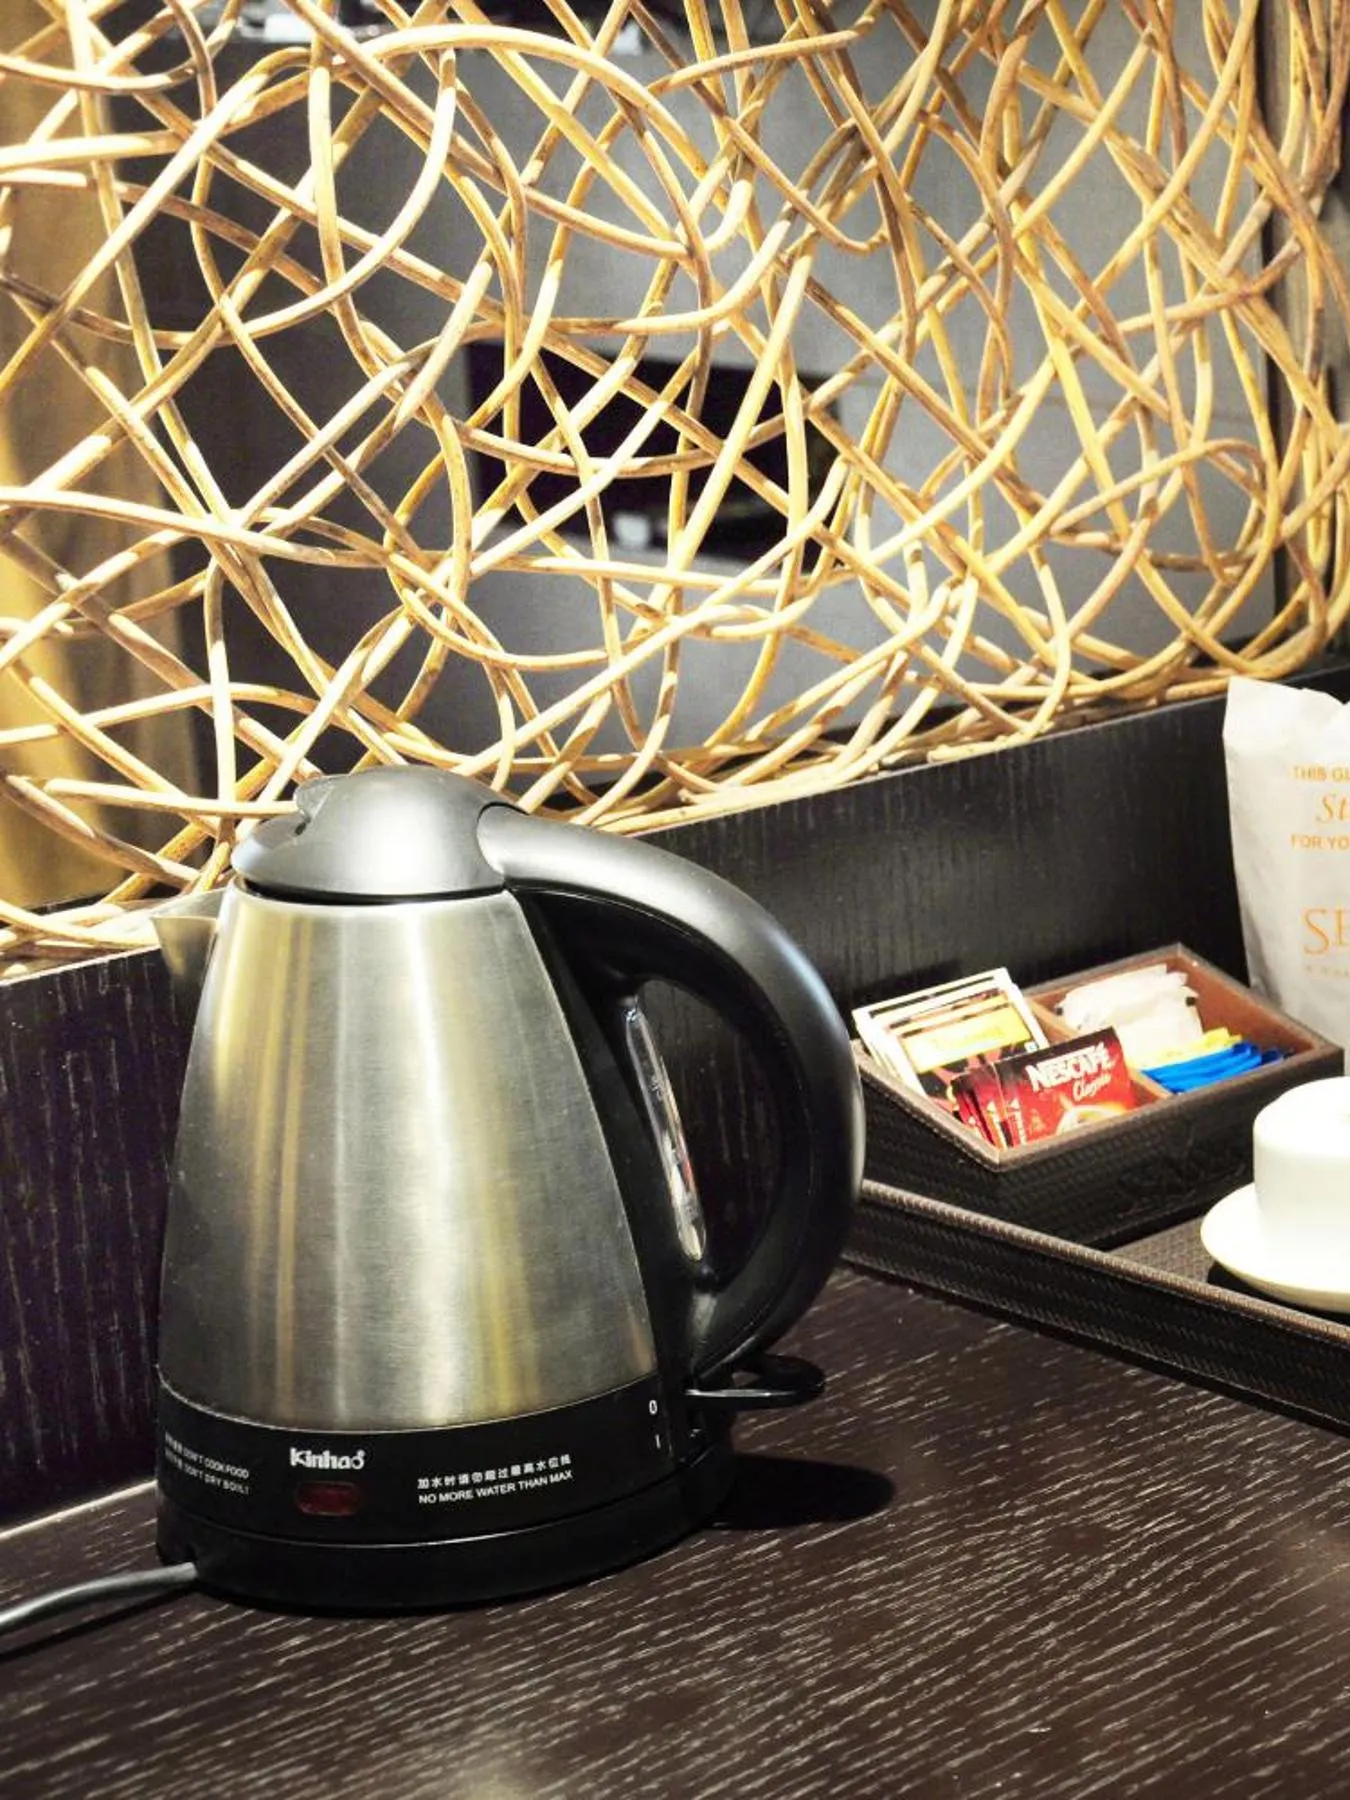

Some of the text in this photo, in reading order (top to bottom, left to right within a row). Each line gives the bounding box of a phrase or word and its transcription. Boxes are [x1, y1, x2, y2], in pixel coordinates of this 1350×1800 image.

[1294, 765, 1327, 781] THIS
[1291, 833, 1322, 848] FOR
[418, 1468, 574, 1505] NO MORE WATER THAN MAX
